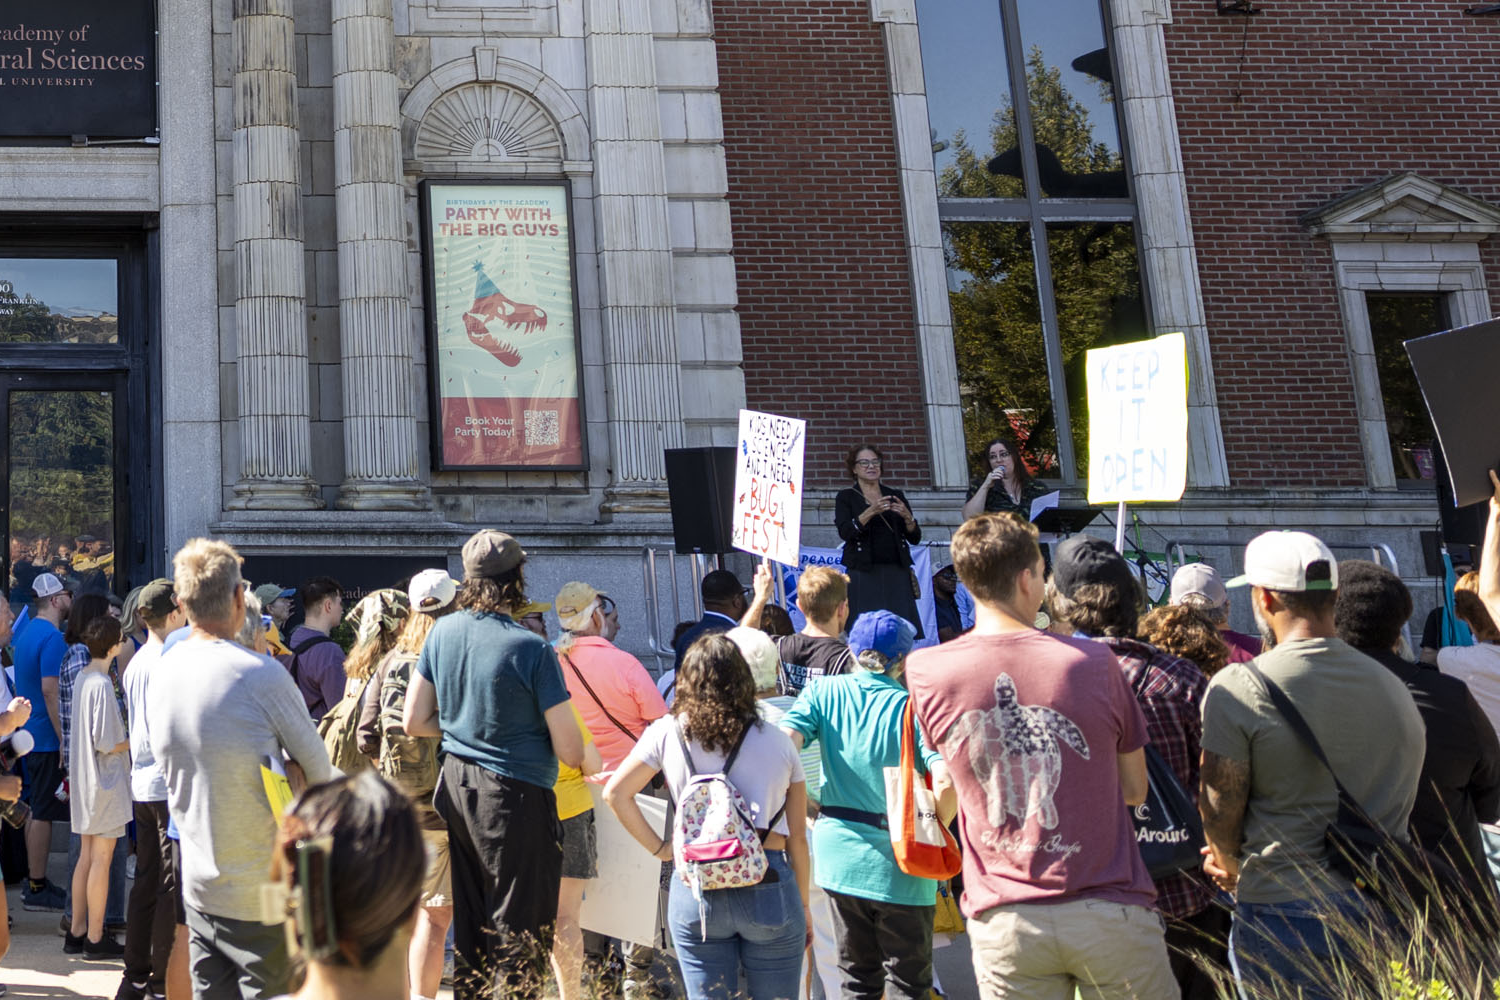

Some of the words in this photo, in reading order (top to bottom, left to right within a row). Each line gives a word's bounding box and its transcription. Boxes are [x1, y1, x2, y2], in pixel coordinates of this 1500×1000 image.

[69, 24, 90, 42] of
[41, 48, 145, 71] Sciences
[11, 77, 96, 86] UNIVERSITY
[445, 207, 500, 220] PARTY
[504, 207, 551, 221] WITH
[438, 223, 473, 236] THE
[512, 223, 559, 236] GUYS
[1101, 350, 1160, 393] KEEP
[465, 416, 491, 425] Book
[492, 416, 514, 425] Your
[749, 415, 767, 436] KIDS
[769, 418, 791, 440] NEED
[1118, 397, 1146, 443] IT
[454, 427, 481, 439] Party
[482, 427, 515, 439] Today!
[752, 436, 787, 462] SCIENCE
[770, 463, 792, 483] NEED
[1101, 447, 1167, 493] OPEN
[750, 477, 779, 517] BUG
[742, 512, 785, 557] FEST
